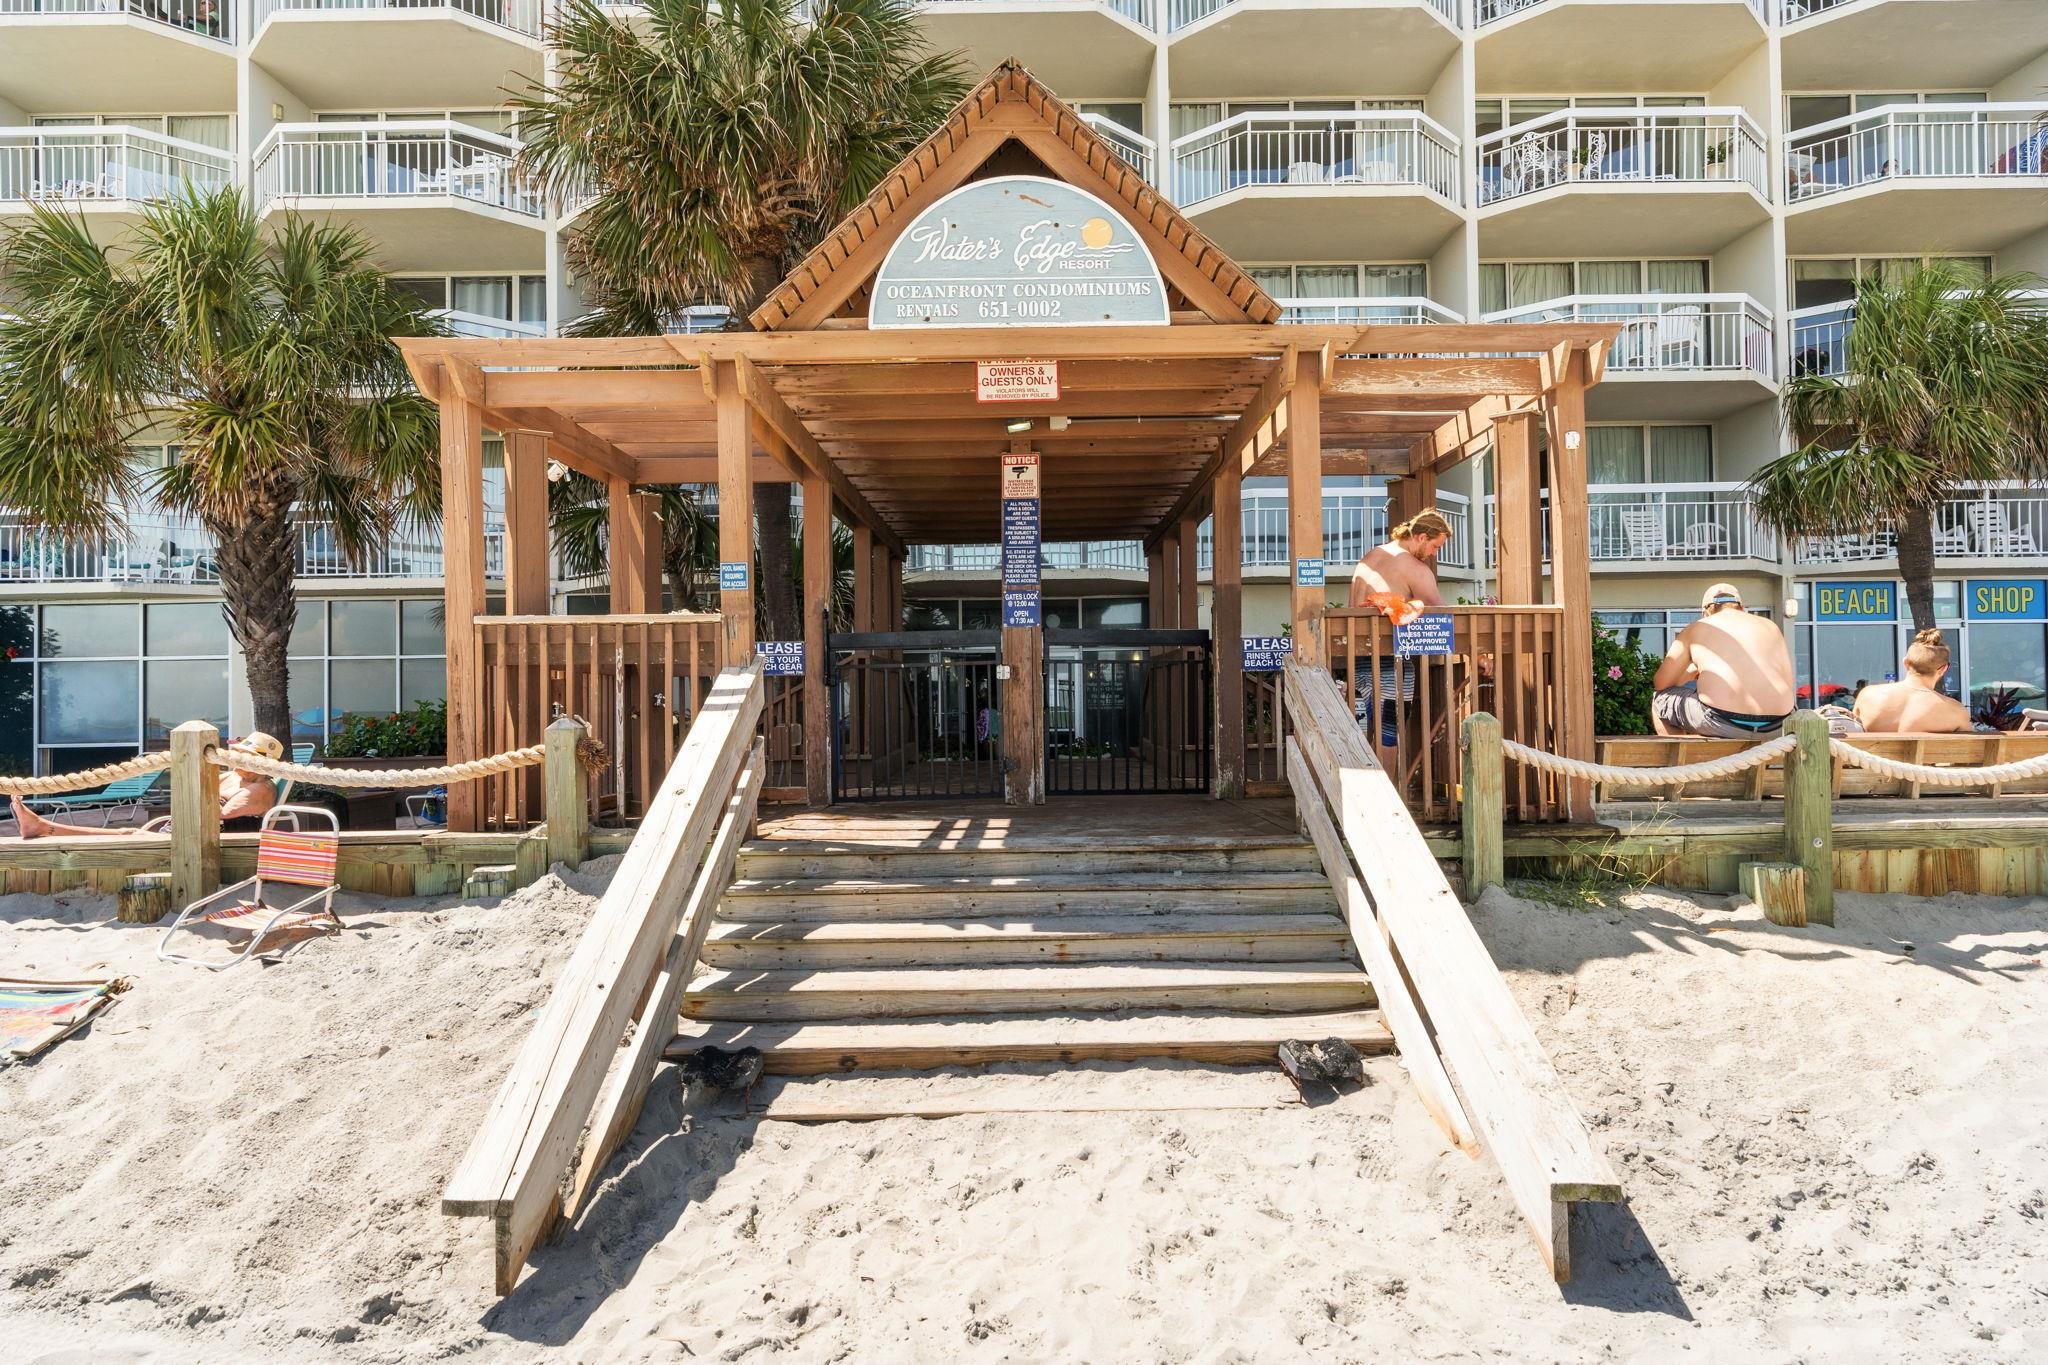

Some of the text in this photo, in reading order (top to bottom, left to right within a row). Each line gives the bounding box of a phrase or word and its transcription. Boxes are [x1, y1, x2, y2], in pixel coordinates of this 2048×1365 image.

[910, 217, 1077, 273] Water's Edge
[1060, 259, 1111, 269] RESORT
[886, 281, 1151, 299] OCEANFRONT CONDOMINIUMS
[896, 300, 1061, 318] RENTALS 651-0002
[989, 366, 1045, 377] OWNERS &
[981, 375, 1053, 387] GUESTS ONLY
[1005, 456, 1036, 465] NOTICE
[1819, 587, 1889, 615] BEACH
[1975, 586, 2035, 613] SHOP
[1598, 613, 1659, 624] OCKTAILS
[755, 642, 803, 654] LEASE
[1246, 652, 1271, 660] RINSE
[778, 663, 803, 671] GEAR
[1244, 659, 1274, 667] BEACH
